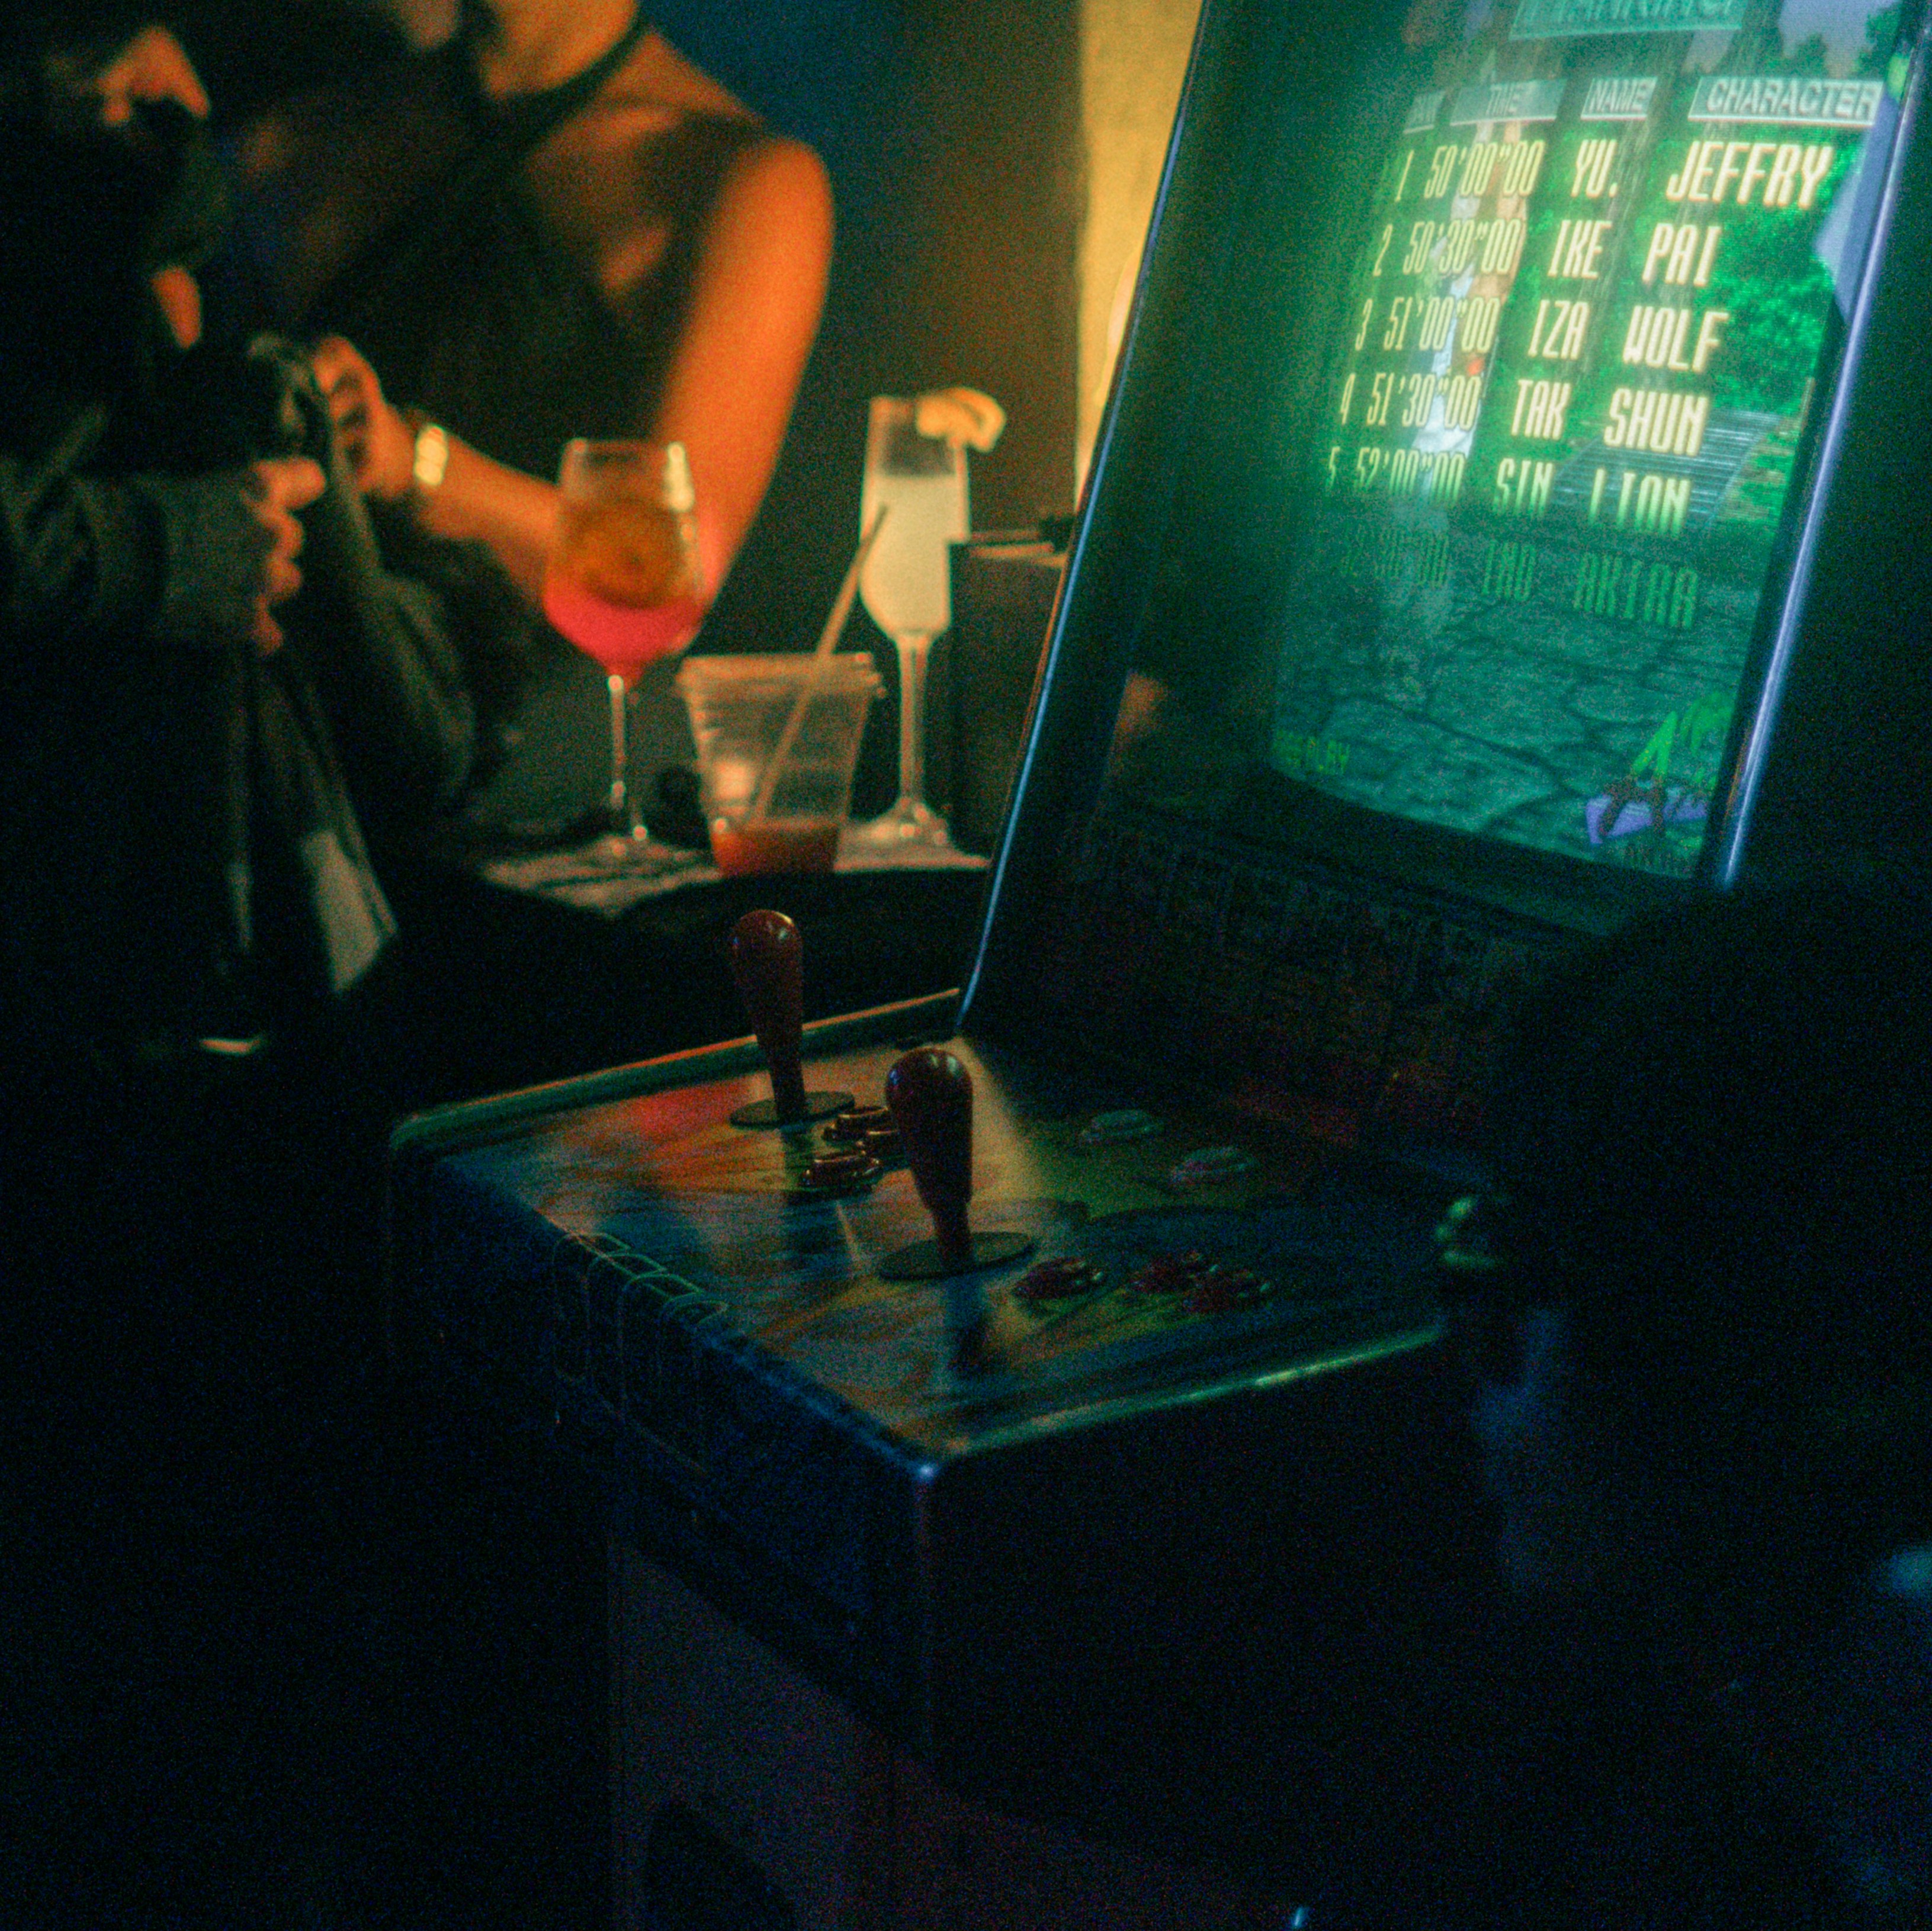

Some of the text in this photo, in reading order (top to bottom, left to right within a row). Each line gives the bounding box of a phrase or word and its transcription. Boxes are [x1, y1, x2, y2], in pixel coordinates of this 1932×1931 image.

[1589, 78, 1650, 113] NAME
[1706, 79, 1880, 120] CHARACTER
[1395, 150, 1414, 202] 1
[1571, 139, 1618, 198] YU.
[1665, 140, 1834, 210] JEFFRY
[1373, 224, 1392, 276] 2
[1548, 219, 1613, 279] IKE
[1642, 223, 1722, 287] PAI
[1355, 298, 1372, 351] 3
[1528, 299, 1590, 360] IZA
[1623, 305, 1729, 373] WOLF
[1340, 373, 1356, 425] 4
[1511, 379, 1571, 441] TAK
[1604, 388, 1708, 457] SHUN
[1492, 458, 1554, 521] SIN
[1572, 552, 1700, 629] AKIRA
